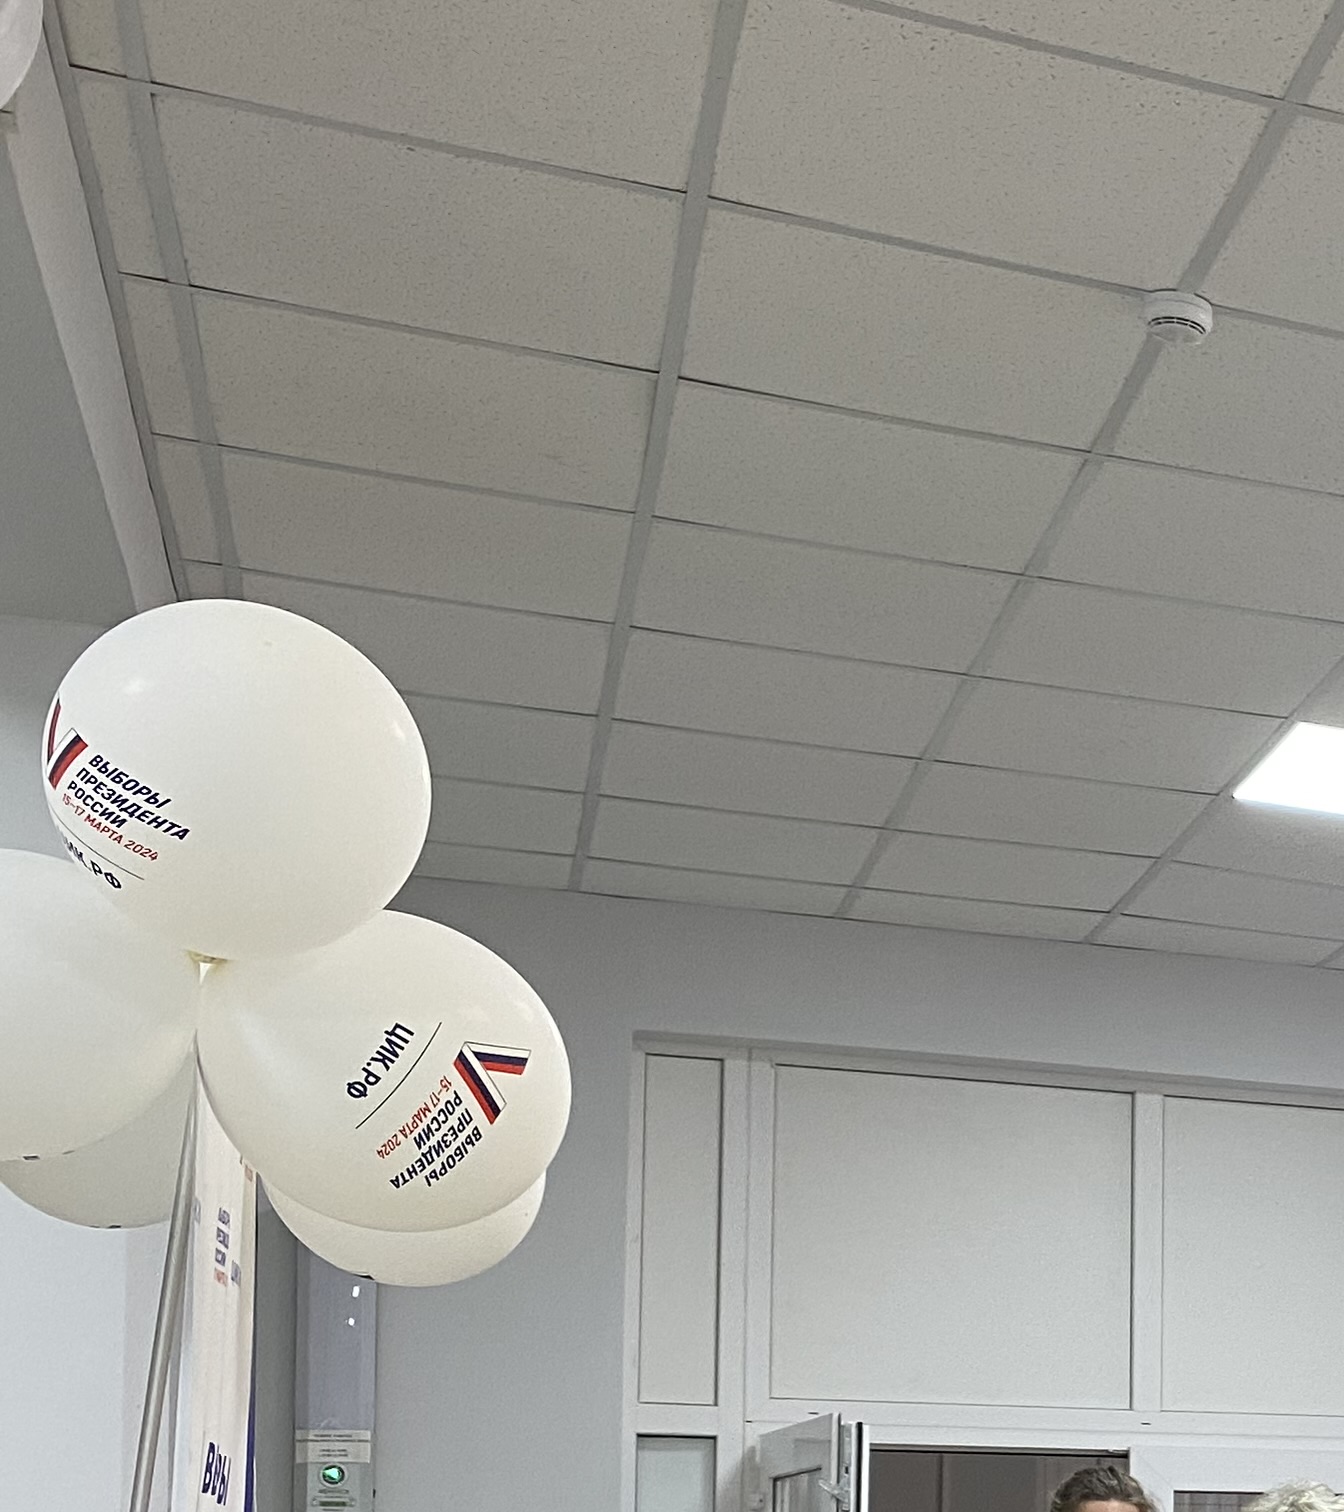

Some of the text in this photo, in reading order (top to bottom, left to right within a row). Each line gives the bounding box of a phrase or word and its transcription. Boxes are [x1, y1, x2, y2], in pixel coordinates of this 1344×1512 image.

[67, 780, 128, 828] РОССИИ
[76, 767, 190, 840] ПРЕЗИДЕНТА
[88, 755, 172, 809] ВЫБОРЫ
[84, 814, 123, 844] МАРТА
[124, 840, 159, 861] 2024
[346, 1022, 415, 1099] ЦИК.РФ
[376, 1133, 402, 1160] 2024
[389, 1107, 474, 1189] ПРЕЗИДЕНТА
[399, 1102, 433, 1139] МАРТА
[413, 1090, 463, 1151] РОССИИ
[424, 1125, 483, 1187] ВЫБОРЫ
